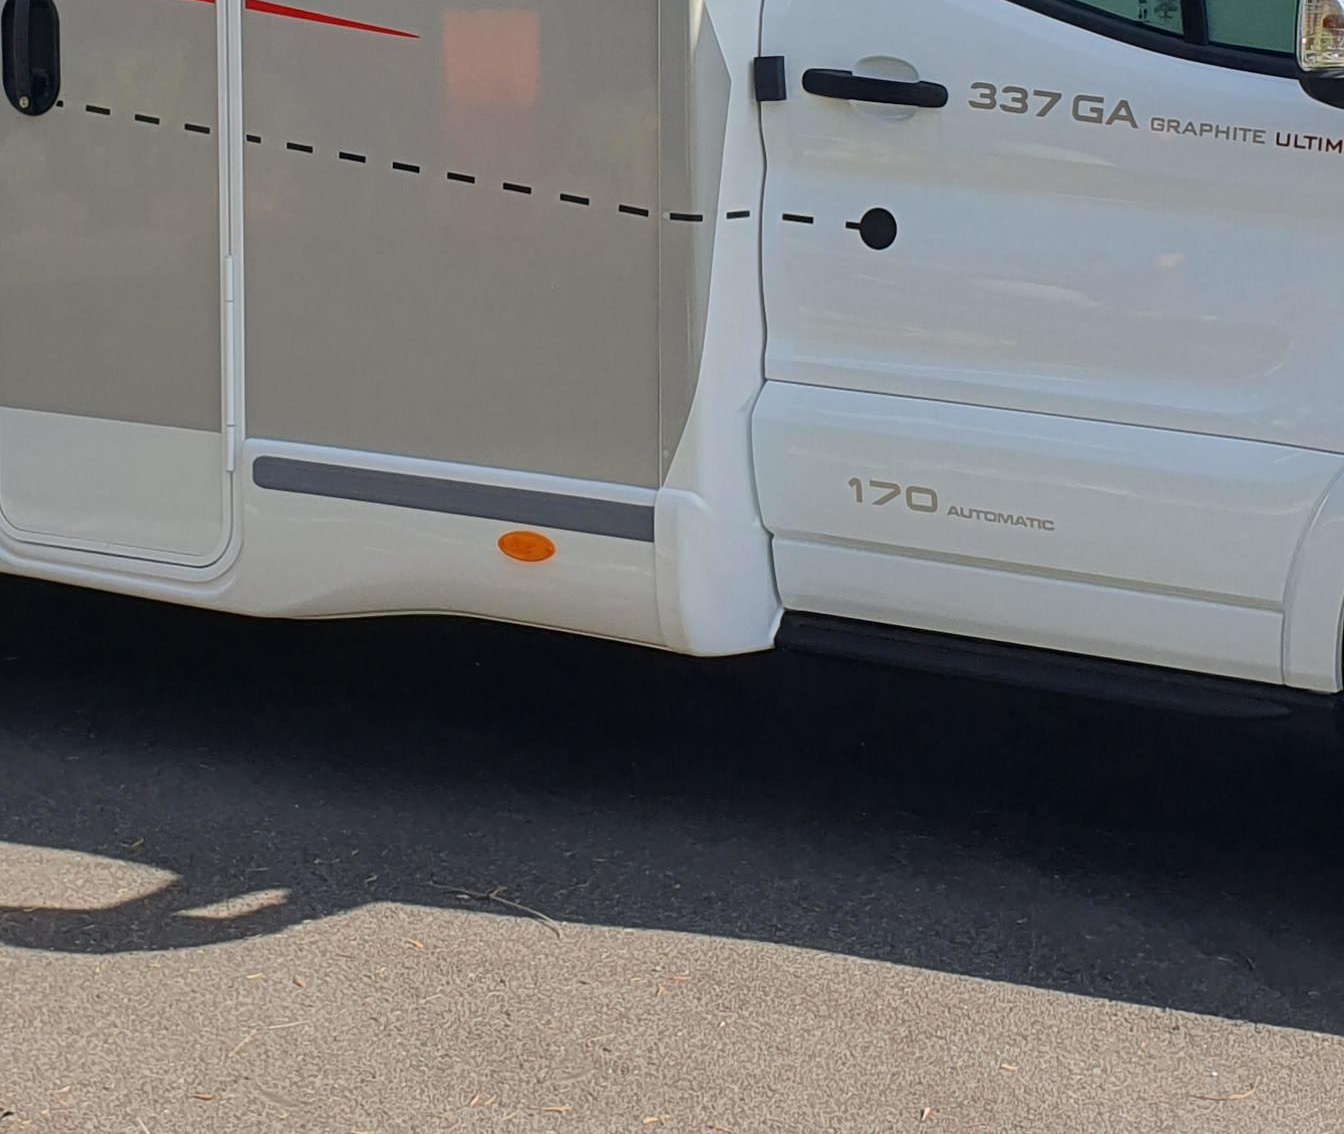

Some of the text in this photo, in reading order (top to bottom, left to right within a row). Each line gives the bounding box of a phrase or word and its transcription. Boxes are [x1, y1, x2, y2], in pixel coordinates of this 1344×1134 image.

[967, 81, 1063, 118] 337
[1071, 94, 1139, 129] GA
[1150, 117, 1267, 145] GRAPHITE
[847, 477, 1055, 532] 170 AUTOMATIC
